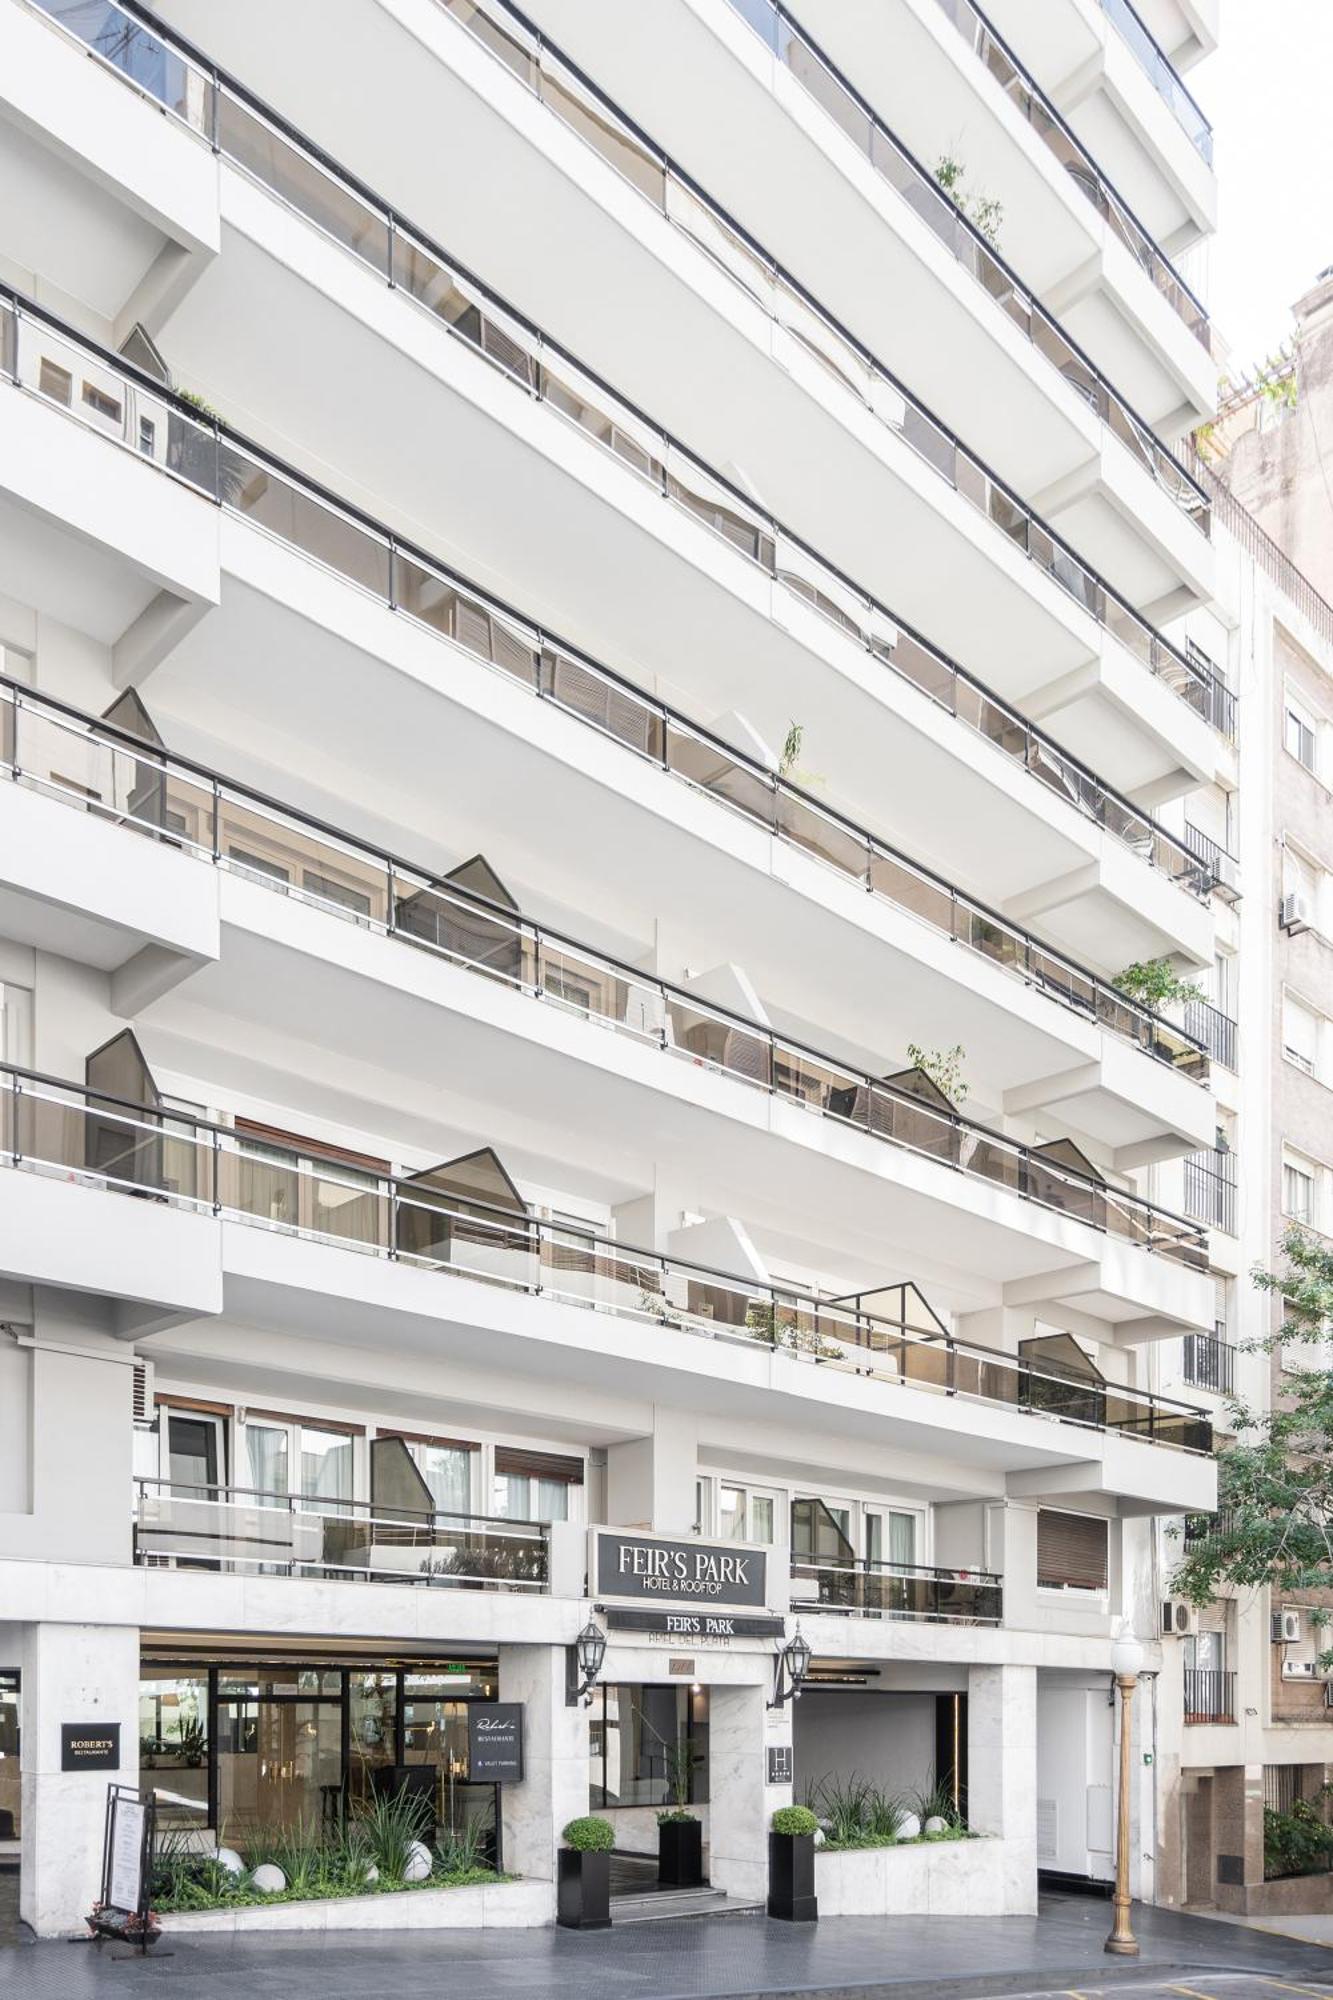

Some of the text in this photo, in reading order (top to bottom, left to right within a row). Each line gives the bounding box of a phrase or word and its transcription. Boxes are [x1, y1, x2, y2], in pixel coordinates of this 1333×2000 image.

[618, 1545, 750, 1585] FEIR'S PARK
[643, 1576, 722, 1594] HOTEL & ROOFTOP
[666, 1616, 735, 1635] FEIR'S PARK
[774, 1748, 789, 1771] H
